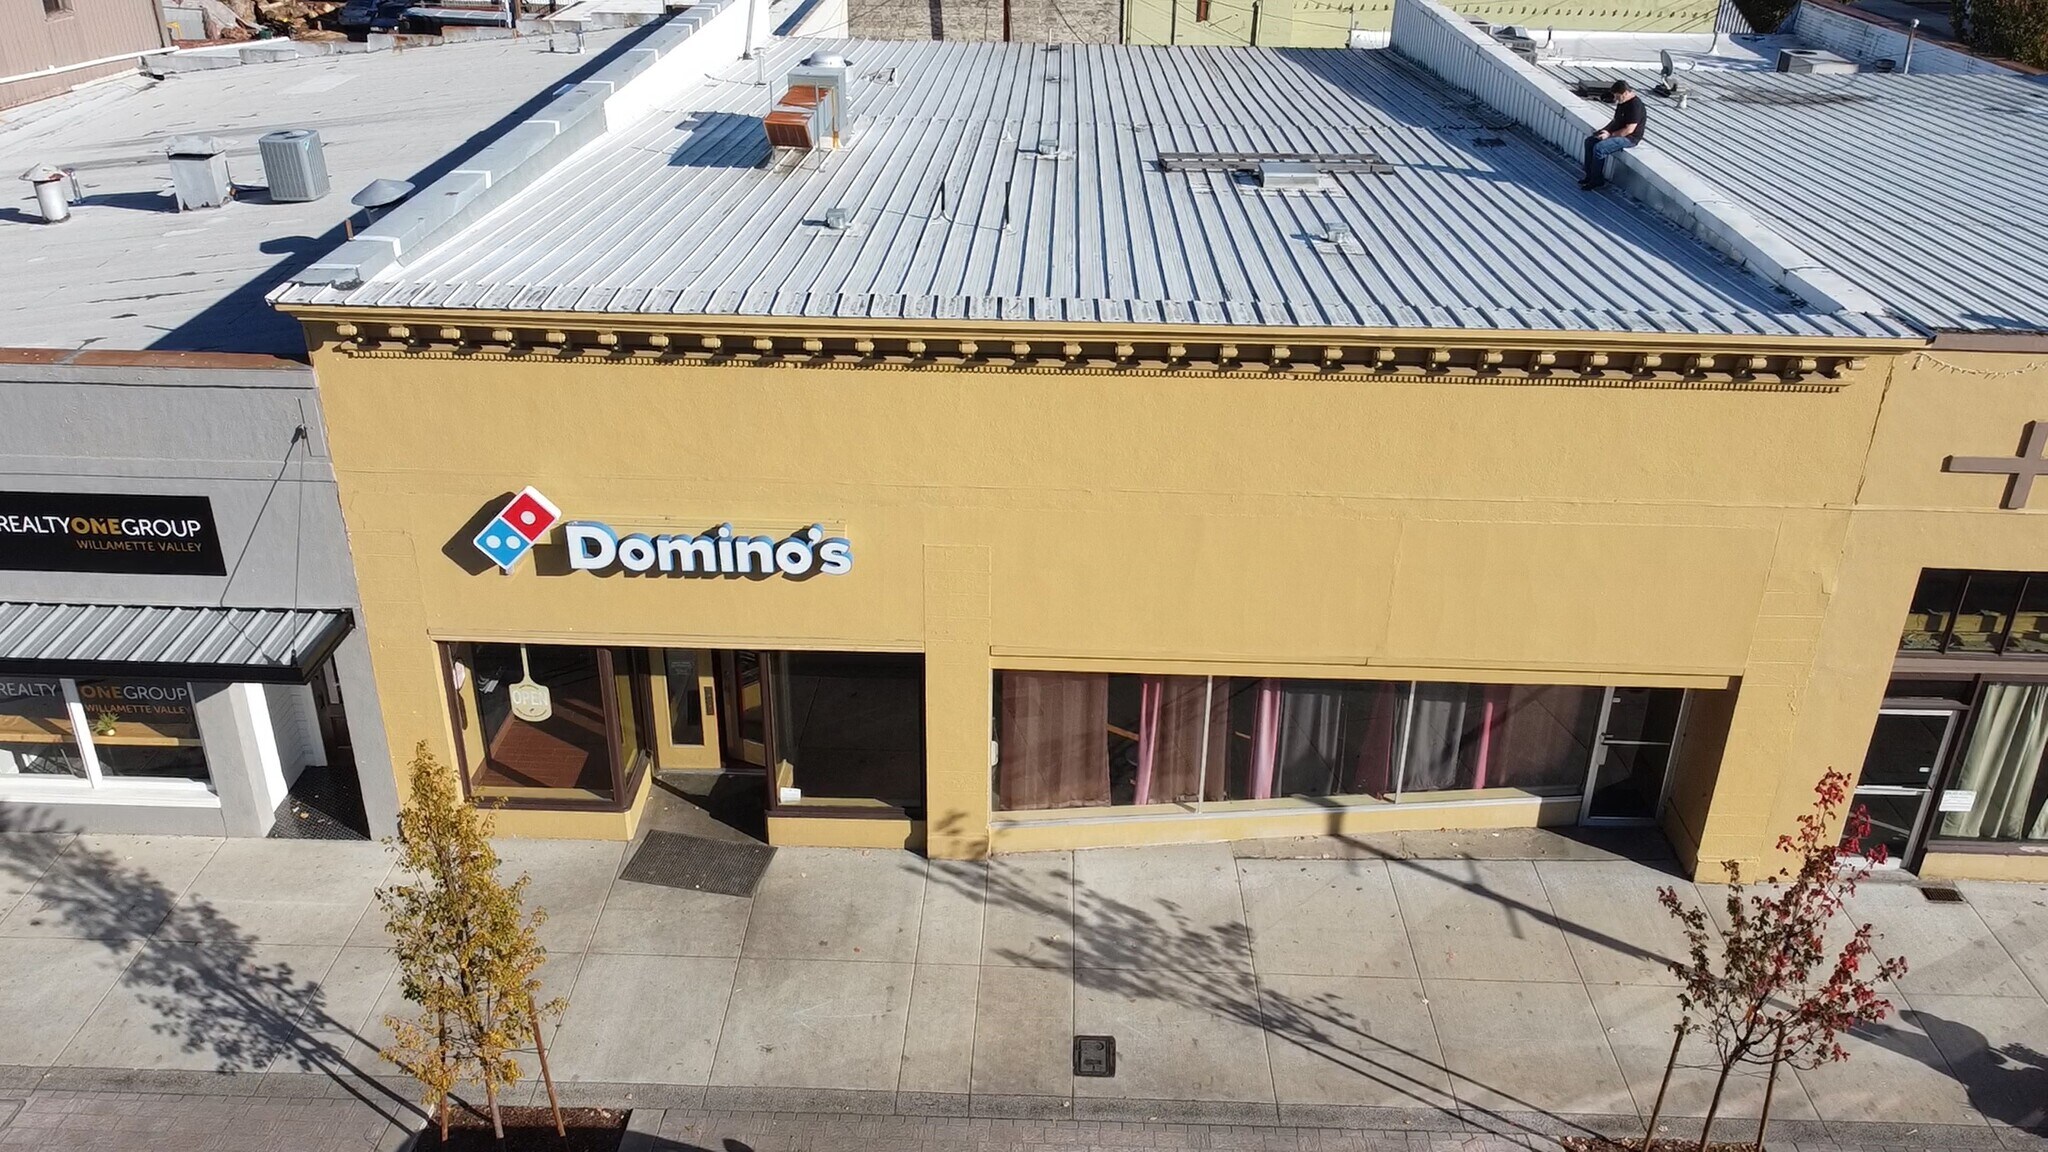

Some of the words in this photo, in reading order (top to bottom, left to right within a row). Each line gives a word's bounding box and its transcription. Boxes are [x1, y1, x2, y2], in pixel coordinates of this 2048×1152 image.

[76, 539, 154, 551] WILLAMETTE
[157, 541, 202, 552] VALLEY
[565, 521, 852, 575] Domino's
[513, 690, 549, 706] OPEN
[85, 703, 152, 714] WILLAMETTE
